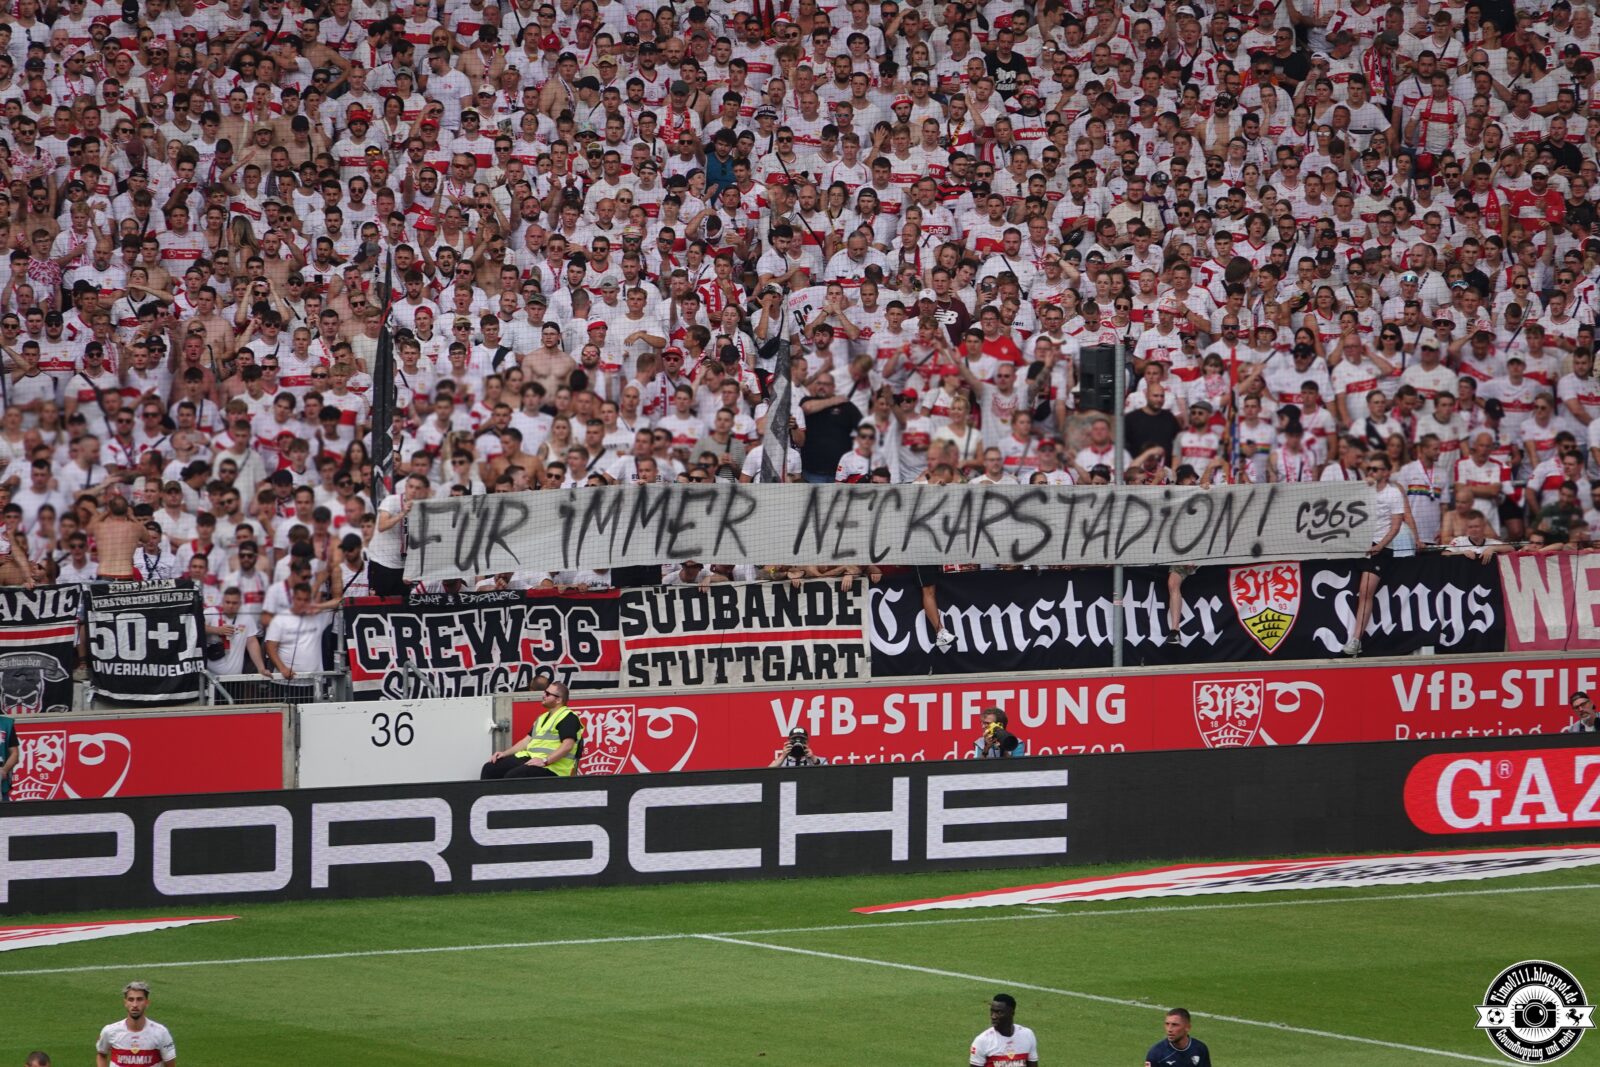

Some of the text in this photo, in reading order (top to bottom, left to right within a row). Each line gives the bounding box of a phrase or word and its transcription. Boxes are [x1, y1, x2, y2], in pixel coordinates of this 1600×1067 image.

[409, 494, 529, 575] FÜR
[109, 579, 176, 593] EHRE ALLEN
[162, 592, 194, 602] ULTRAS
[620, 579, 862, 636] SÜDBANDE
[88, 611, 203, 661] 50+1
[628, 643, 865, 687] STUTTGART
[770, 684, 1126, 738] VfB-STIFTUNG
[1391, 666, 1598, 712] VfB-STIF
[371, 711, 414, 748] 36
[1210, 719, 1247, 728] 18 93
[608, 746, 618, 754] 93
[0, 769, 1068, 904] PORSCHE
